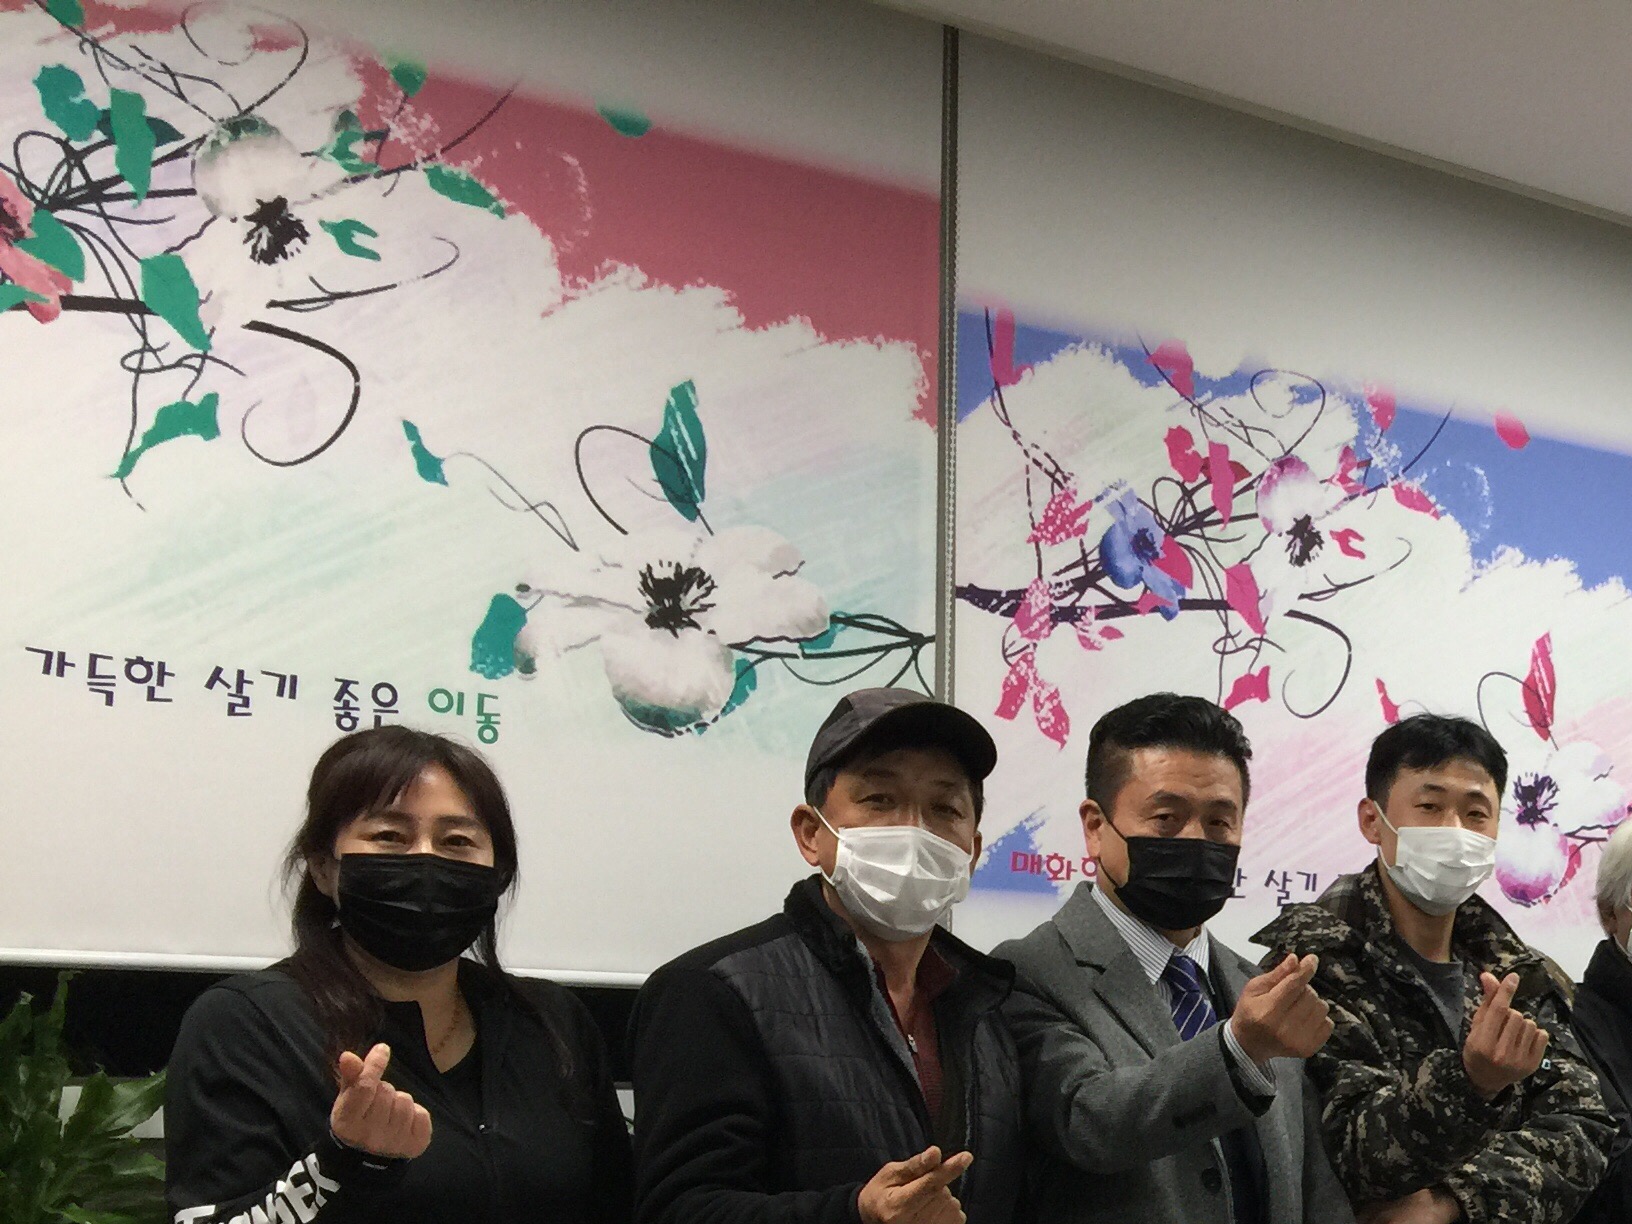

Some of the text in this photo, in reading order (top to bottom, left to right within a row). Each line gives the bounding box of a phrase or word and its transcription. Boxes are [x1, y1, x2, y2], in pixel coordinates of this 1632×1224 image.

[25, 647, 501, 745] 가득한 살기 좋은 이동
[1264, 869, 1318, 907] 살기
